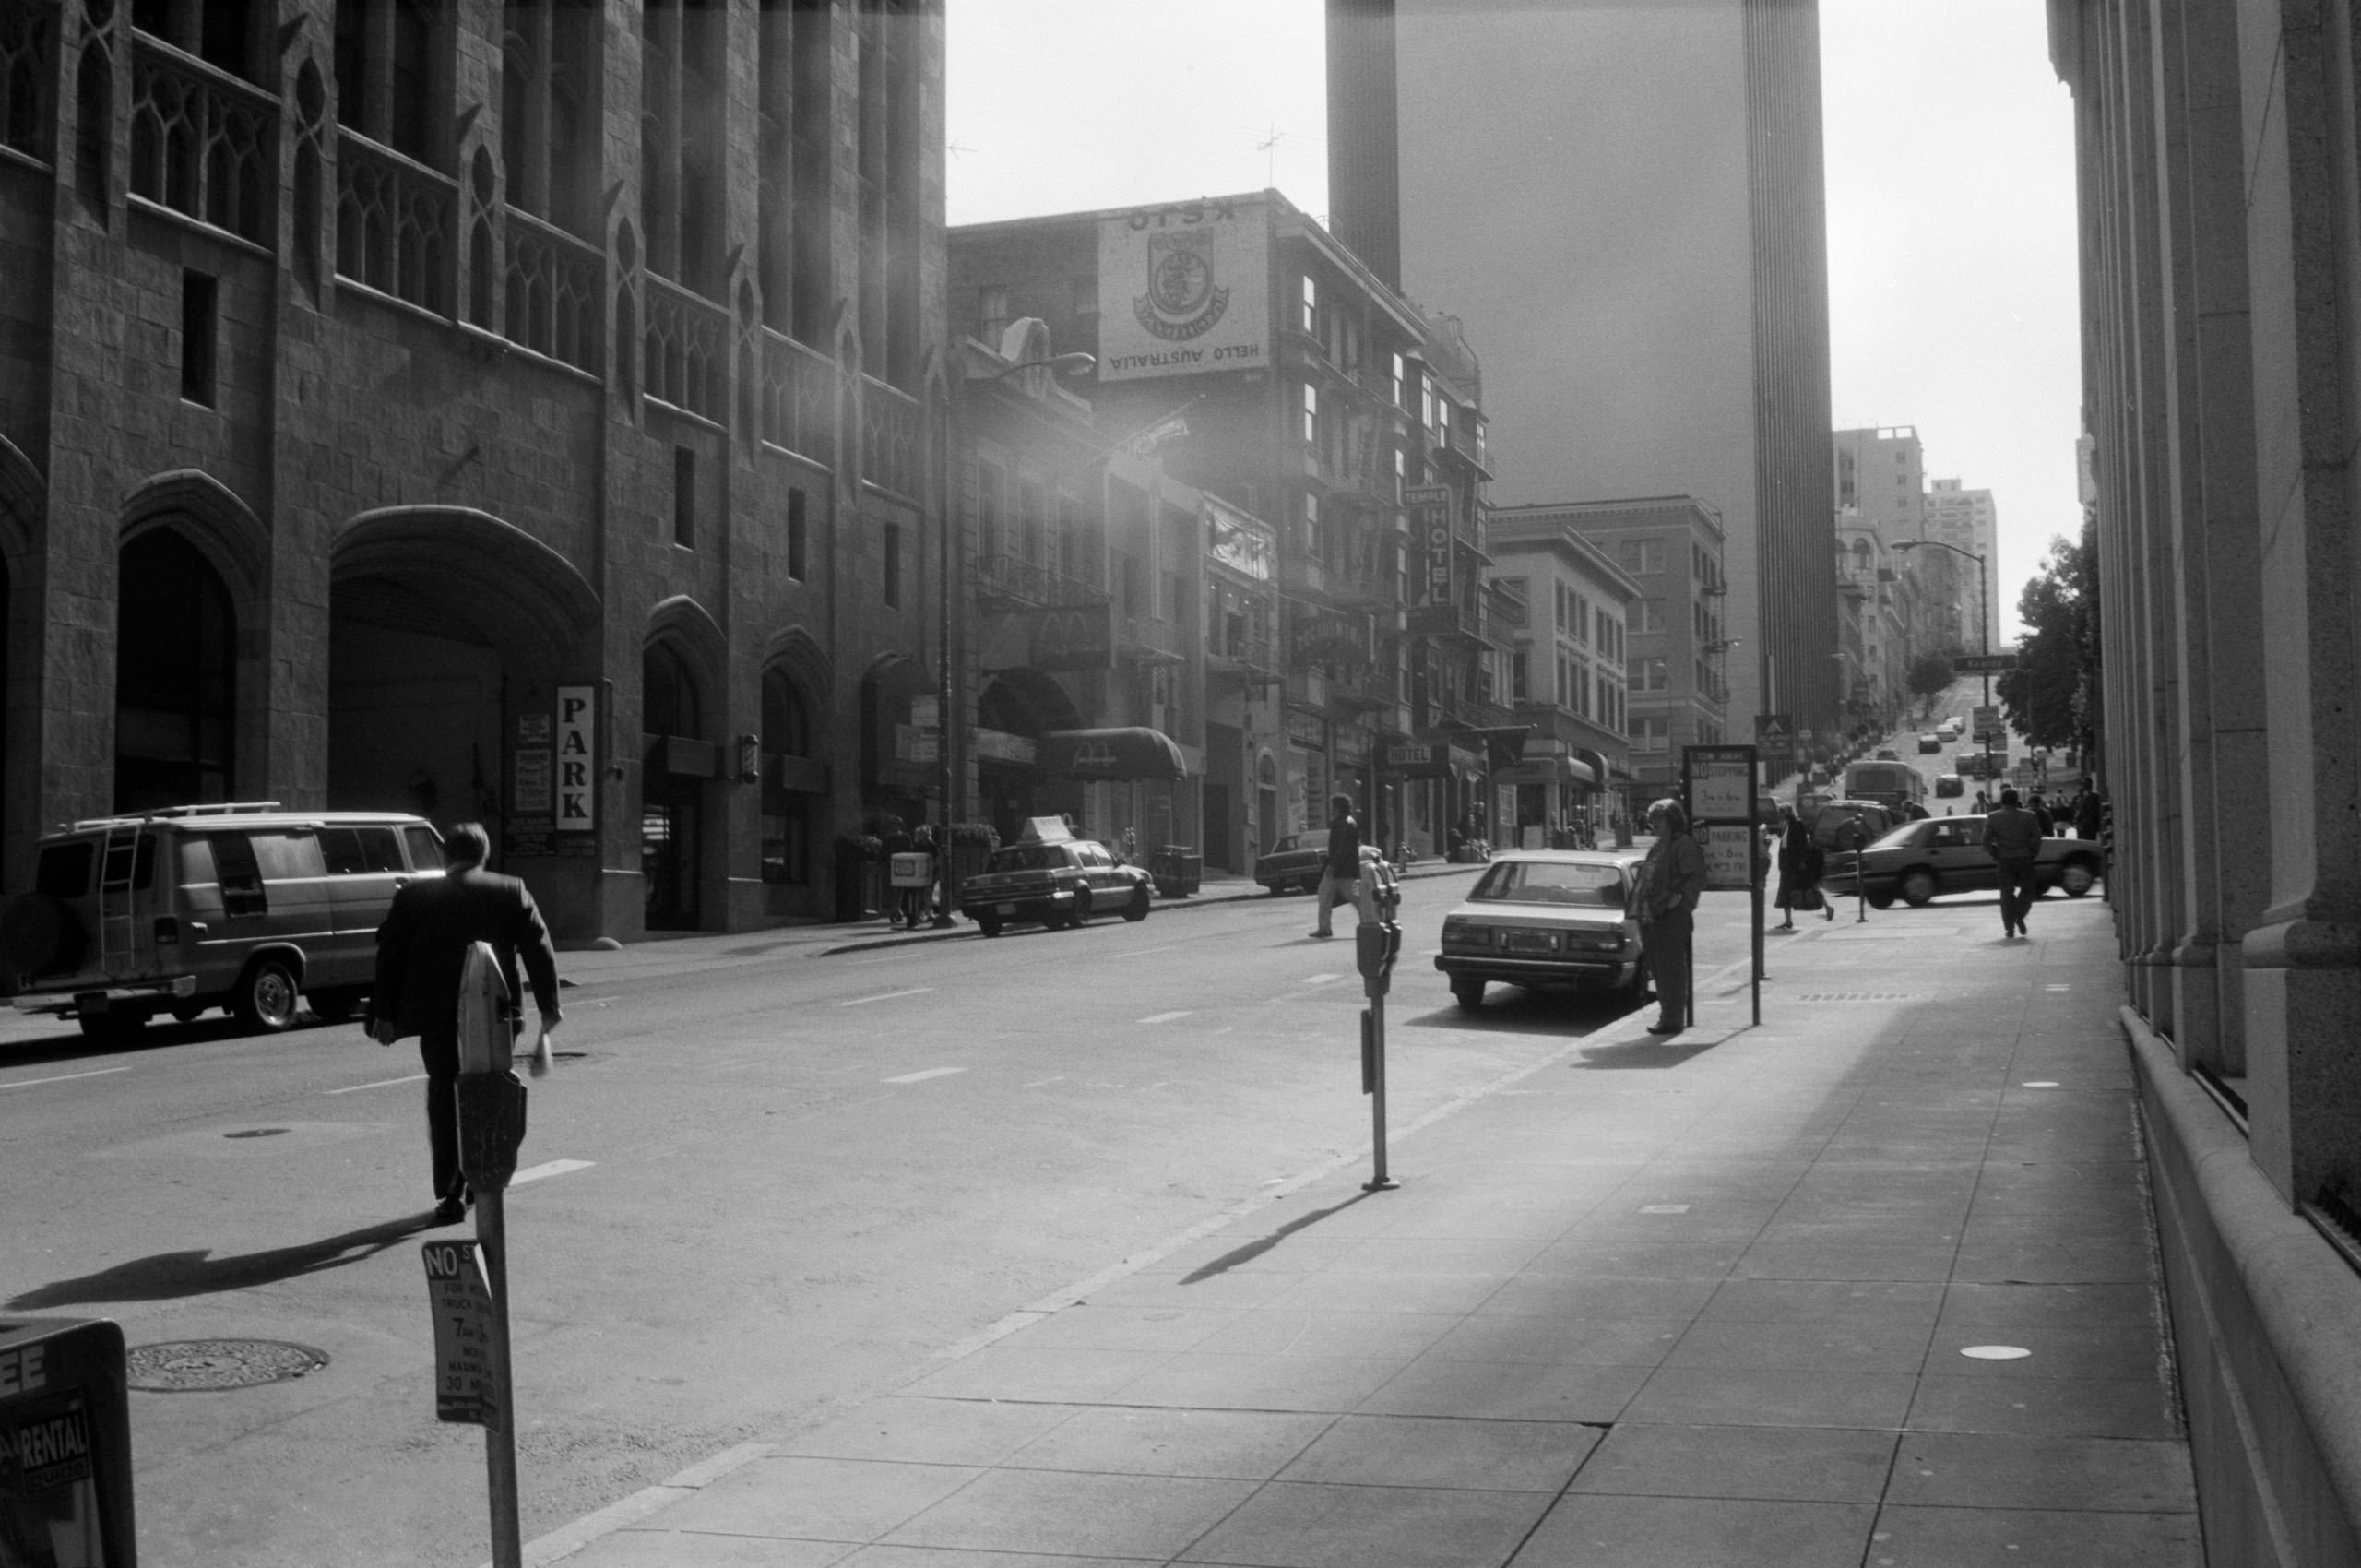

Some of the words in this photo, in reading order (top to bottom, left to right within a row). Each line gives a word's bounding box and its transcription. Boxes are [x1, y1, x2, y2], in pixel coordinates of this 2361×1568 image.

[1109, 349, 1204, 369] AUSTRALIA
[1214, 345, 1259, 360] HELLO
[1405, 491, 1447, 502] TEMPLE
[1431, 508, 1448, 603] HOTEL
[562, 698, 588, 818] PARK
[1392, 747, 1426, 761] HOTEL
[1691, 763, 1708, 777] NO
[1711, 831, 1748, 843] PARKING
[423, 1246, 458, 1277] NO
[445, 1375, 462, 1391] 30
[20, 1414, 87, 1469] RENTAL
